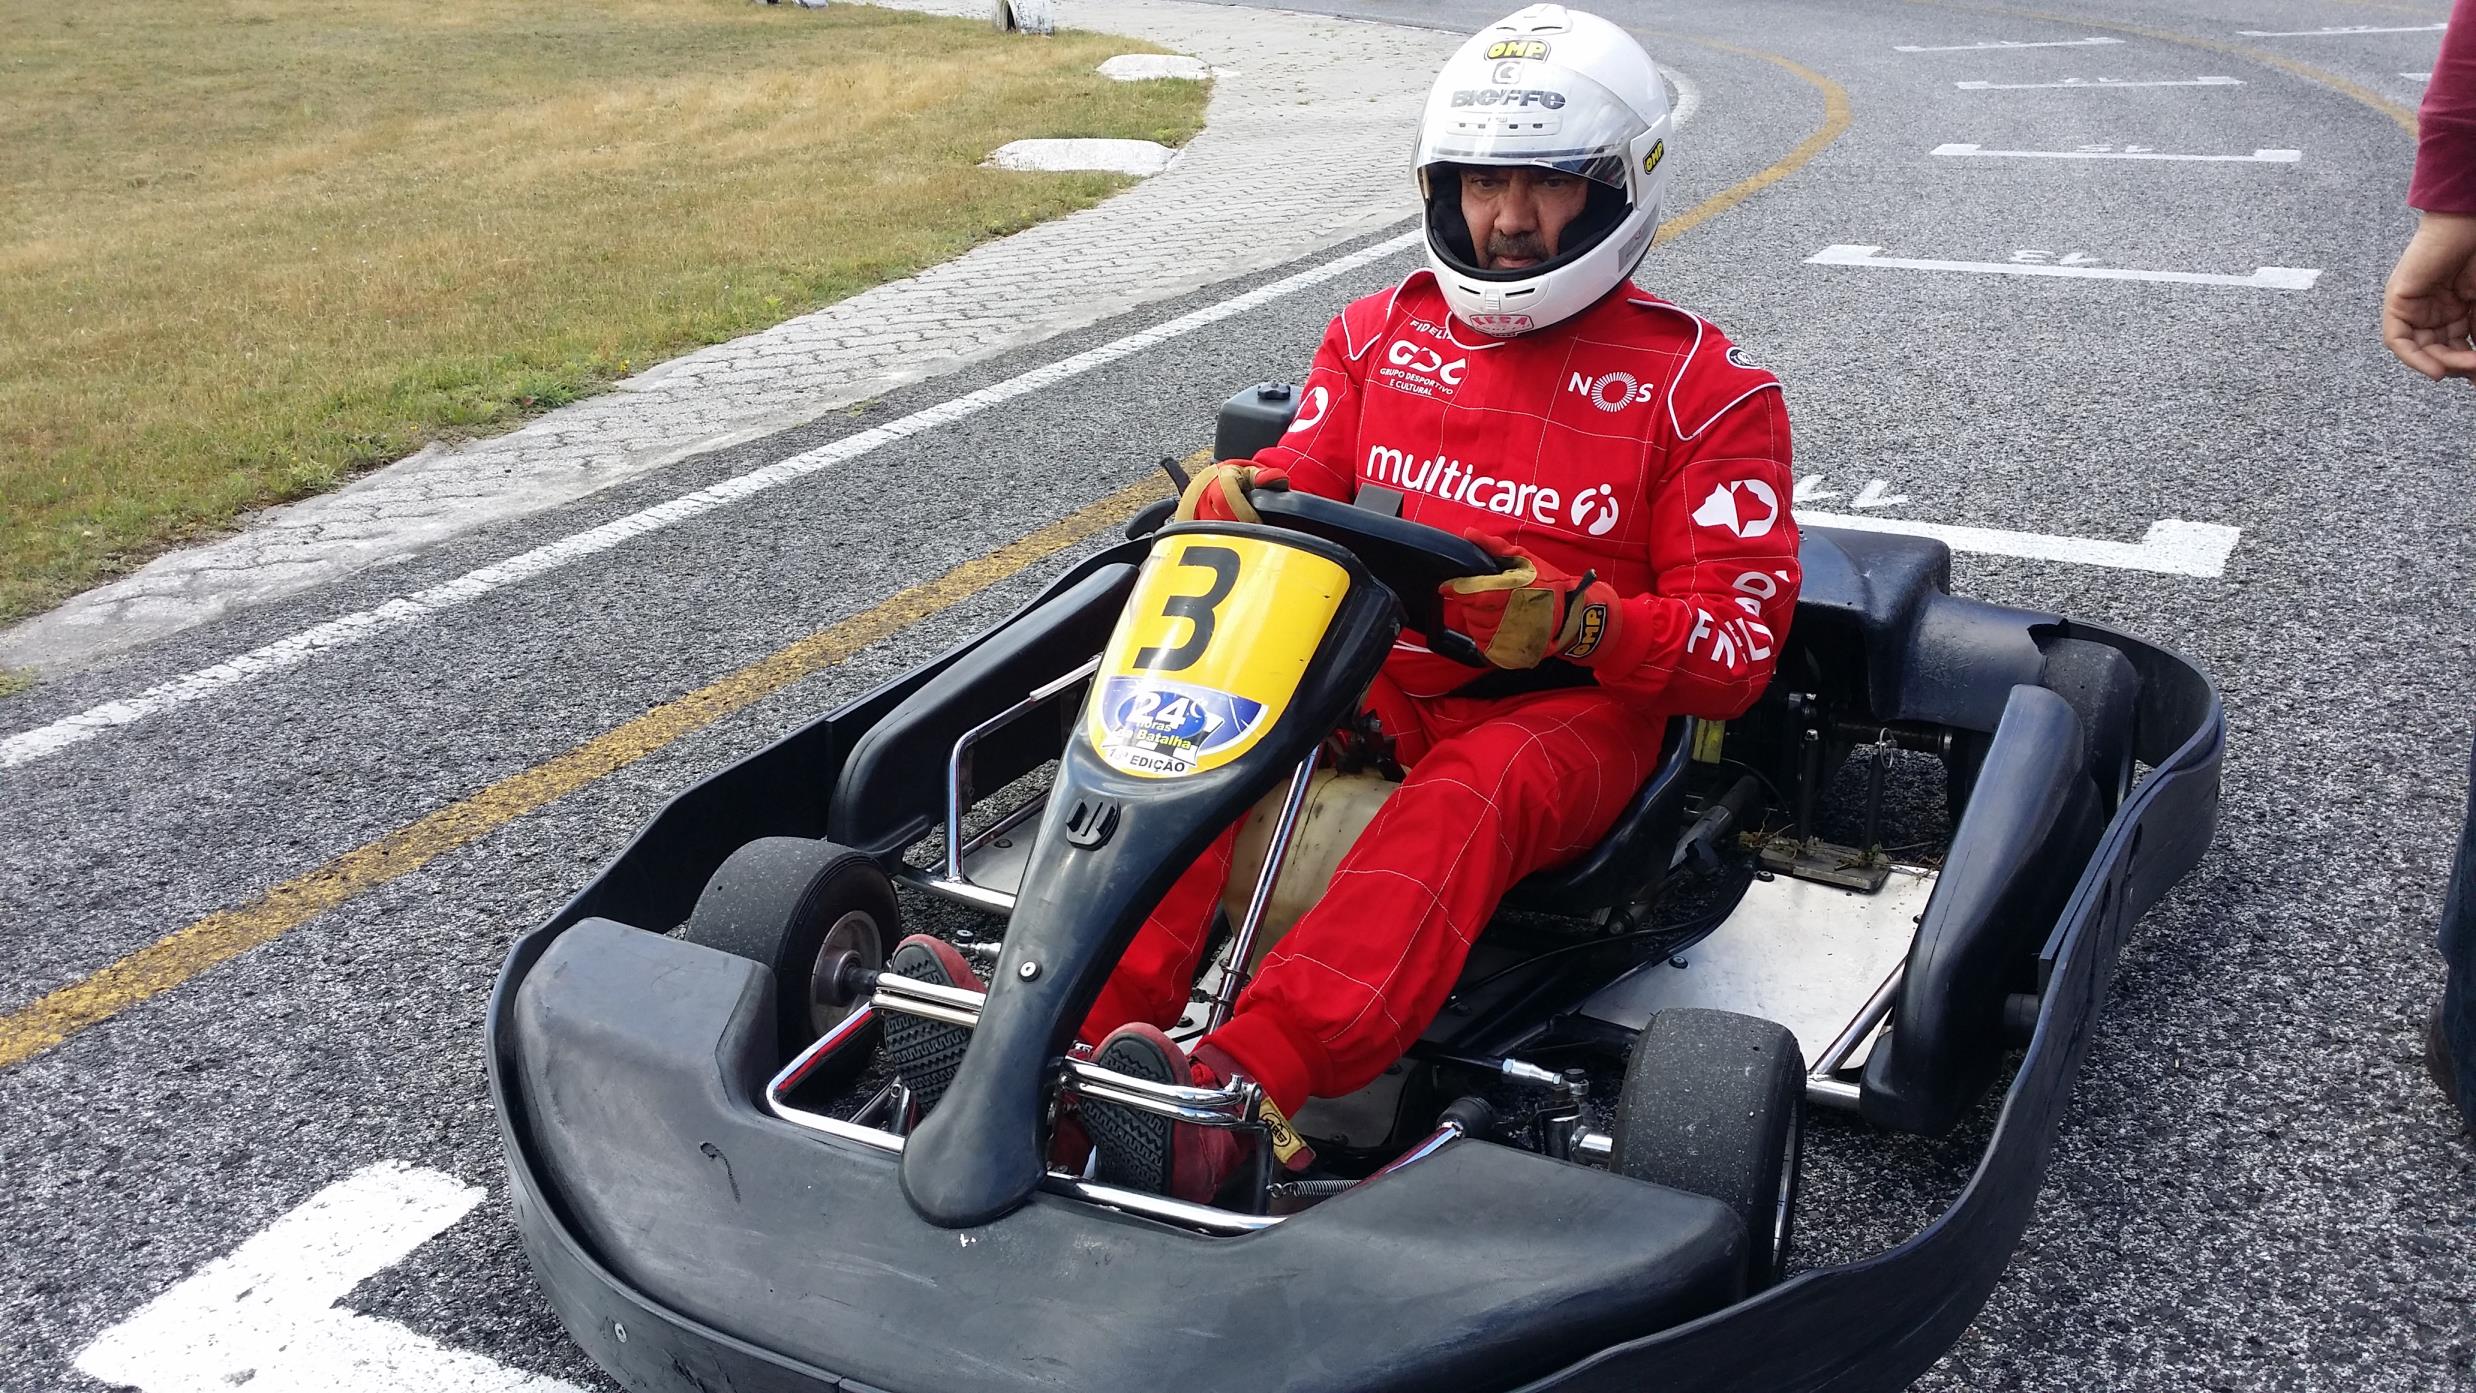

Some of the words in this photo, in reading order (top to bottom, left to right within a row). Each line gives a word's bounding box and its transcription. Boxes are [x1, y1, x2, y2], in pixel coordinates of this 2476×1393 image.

[1486, 40, 1548, 60] OMP
[1645, 140, 1664, 173] OMP
[1388, 339, 1467, 386] GDC
[1380, 367, 1405, 379] GRUPO
[1405, 372, 1454, 395] DESPORTIVO
[1389, 378, 1395, 387] E
[1395, 380, 1433, 396] CULTURAL
[1567, 371, 1654, 413] NOS
[1366, 444, 1560, 525] multicare
[1132, 546, 1241, 672] 3
[1572, 608, 1601, 655] OMP
[1127, 691, 1190, 730] 24
[1136, 729, 1192, 751] Batalha
[1130, 753, 1186, 773] EDIÇÃO
